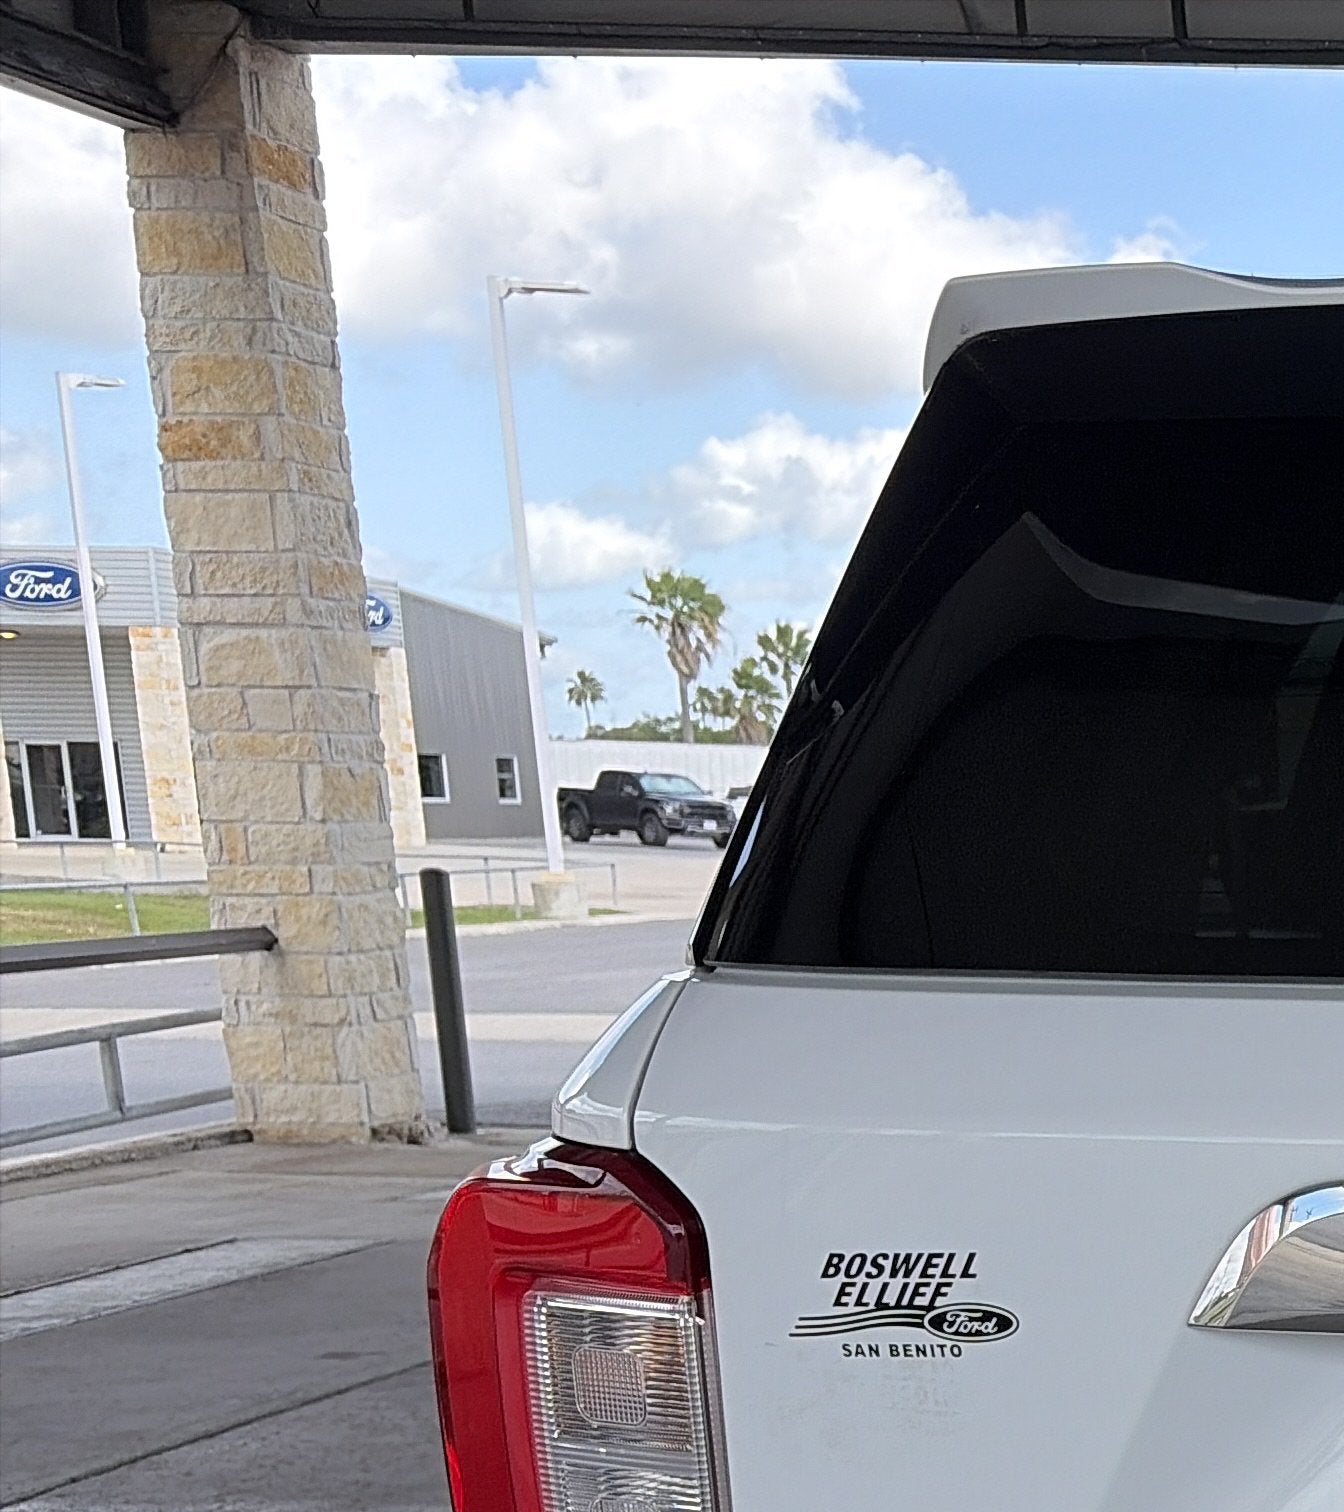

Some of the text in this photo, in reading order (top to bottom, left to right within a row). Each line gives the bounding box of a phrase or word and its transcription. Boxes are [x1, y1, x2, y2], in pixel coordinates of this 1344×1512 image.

[5, 570, 72, 599] Ford
[820, 1252, 978, 1279] BOSWELL
[833, 1281, 953, 1308] ELLIFF
[942, 1311, 998, 1334] Ford
[842, 1343, 963, 1358] SAN BENITO
